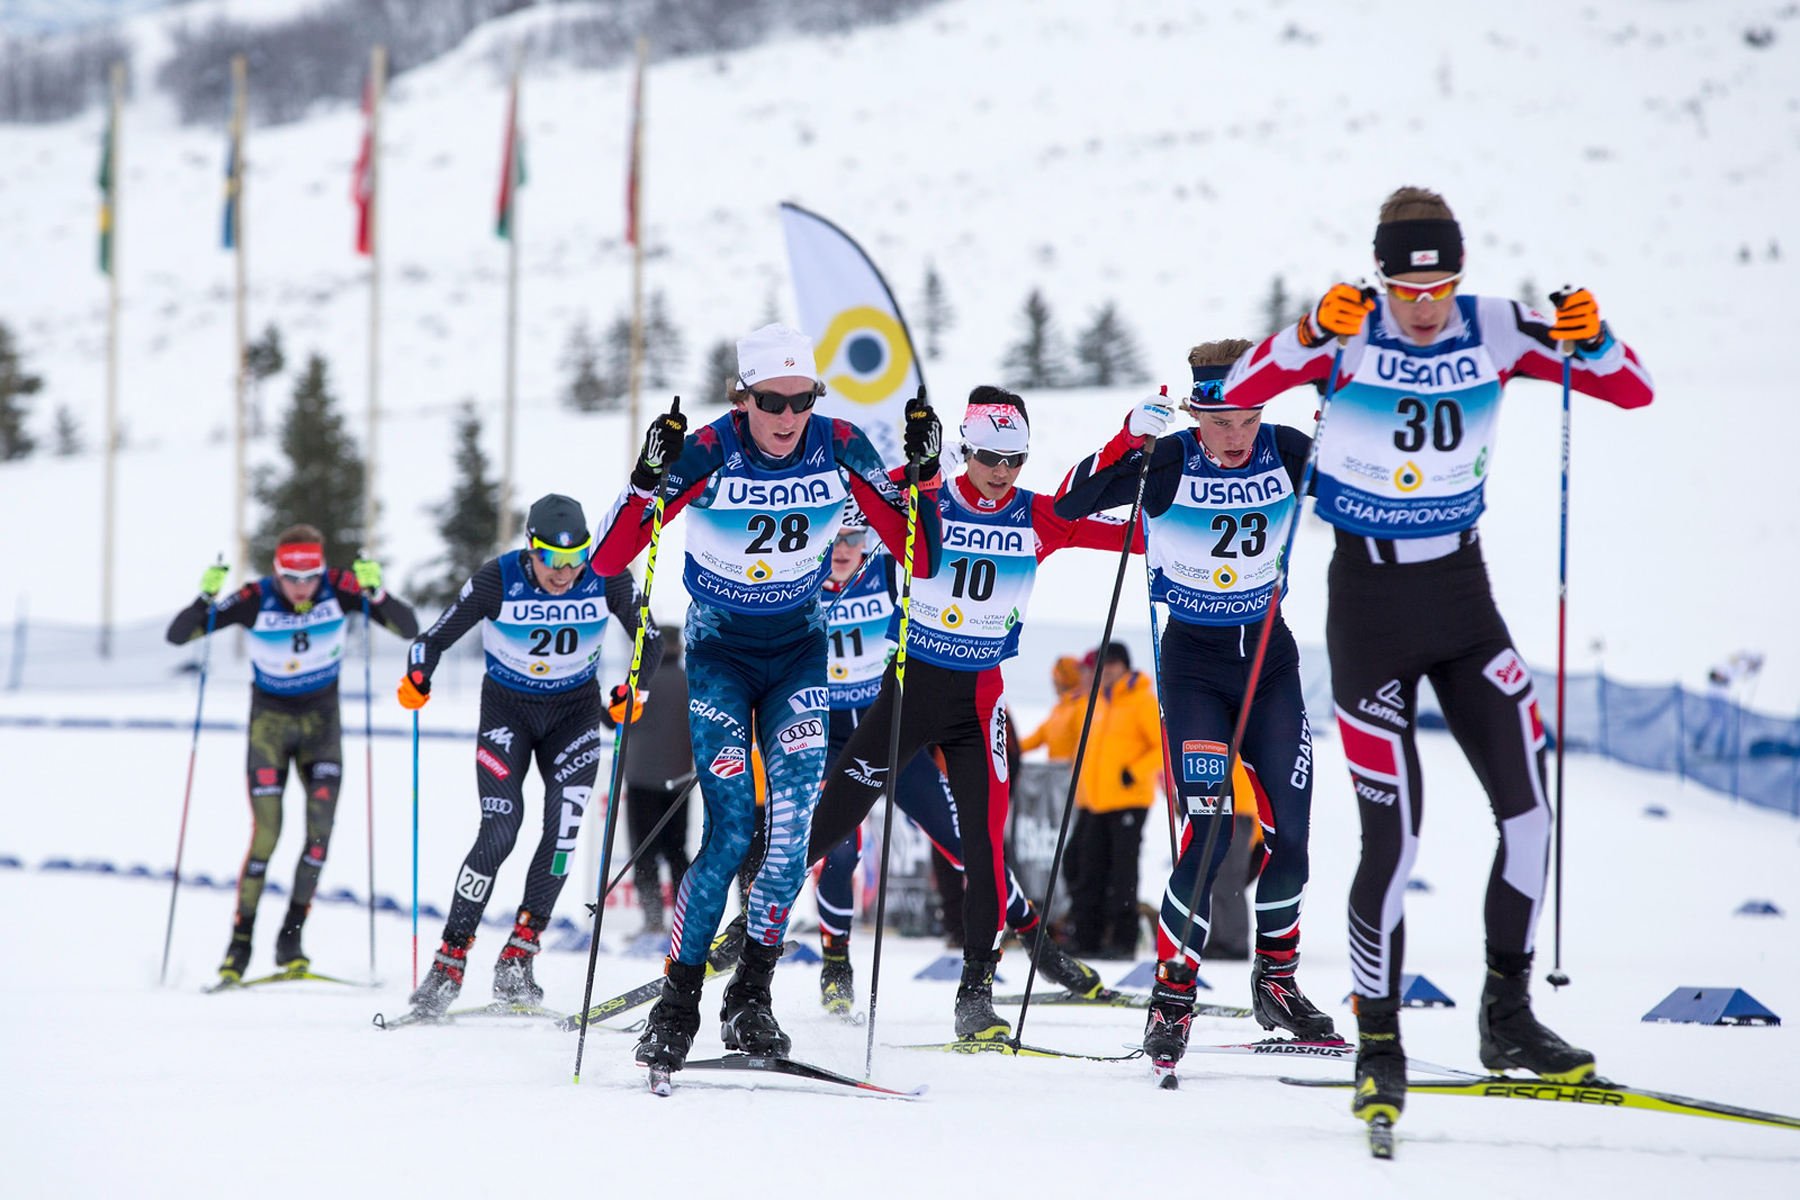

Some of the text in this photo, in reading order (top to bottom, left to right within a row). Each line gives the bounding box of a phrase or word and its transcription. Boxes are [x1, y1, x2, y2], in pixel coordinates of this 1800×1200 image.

[1377, 355, 1480, 387] USANA
[665, 418, 682, 431] TOKO
[909, 410, 927, 419] TOKO
[1394, 397, 1464, 452] 30
[668, 473, 683, 485] ean
[1190, 476, 1283, 504] USANA
[728, 480, 830, 506] USANA
[1132, 477, 1147, 523] MADSHUS
[745, 513, 810, 555] 28
[1211, 512, 1268, 559] 23
[701, 553, 742, 575] HOLLOW
[1171, 565, 1211, 580] HOLLOW
[1174, 560, 1210, 574] SOLDIER
[697, 566, 822, 603] CHAMPIONSHIP
[702, 570, 723, 583] USANA
[760, 584, 785, 592] JUNIOR
[950, 557, 996, 601] 10
[1166, 589, 1272, 614] CHAMPIONSH
[1172, 583, 1191, 596] USANA
[1201, 592, 1227, 600] NORDIC
[1228, 592, 1250, 600] JUNIOR
[513, 602, 597, 621] USANA
[829, 599, 883, 621] ANA
[909, 598, 939, 613] OLDIER
[910, 603, 938, 619] OLLOW
[292, 630, 310, 653] 8
[529, 627, 579, 657] 20
[829, 627, 863, 658] 11
[906, 629, 1000, 660] HAMPIONSHI
[929, 631, 952, 642] NORDIC
[952, 637, 974, 646] JUNIOR
[690, 698, 739, 729] CRAFT
[1358, 698, 1409, 729] Löffler
[565, 728, 600, 753] sport
[787, 742, 808, 752] Audi
[721, 748, 744, 756] US
[1290, 718, 1312, 790] CRAFT
[1187, 757, 1225, 776] 1881
[844, 768, 883, 788] MIZUNO
[1356, 782, 1398, 806] TRIA
[460, 872, 486, 899] 20
[1157, 990, 1194, 1001] MADSHUS
[589, 996, 627, 1019] FISCHE
[1358, 1031, 1396, 1041] CHER
[951, 1043, 1004, 1054] FISCHER
[1254, 1044, 1343, 1058] MADSHUS
[1484, 1086, 1626, 1107] FISCHER
